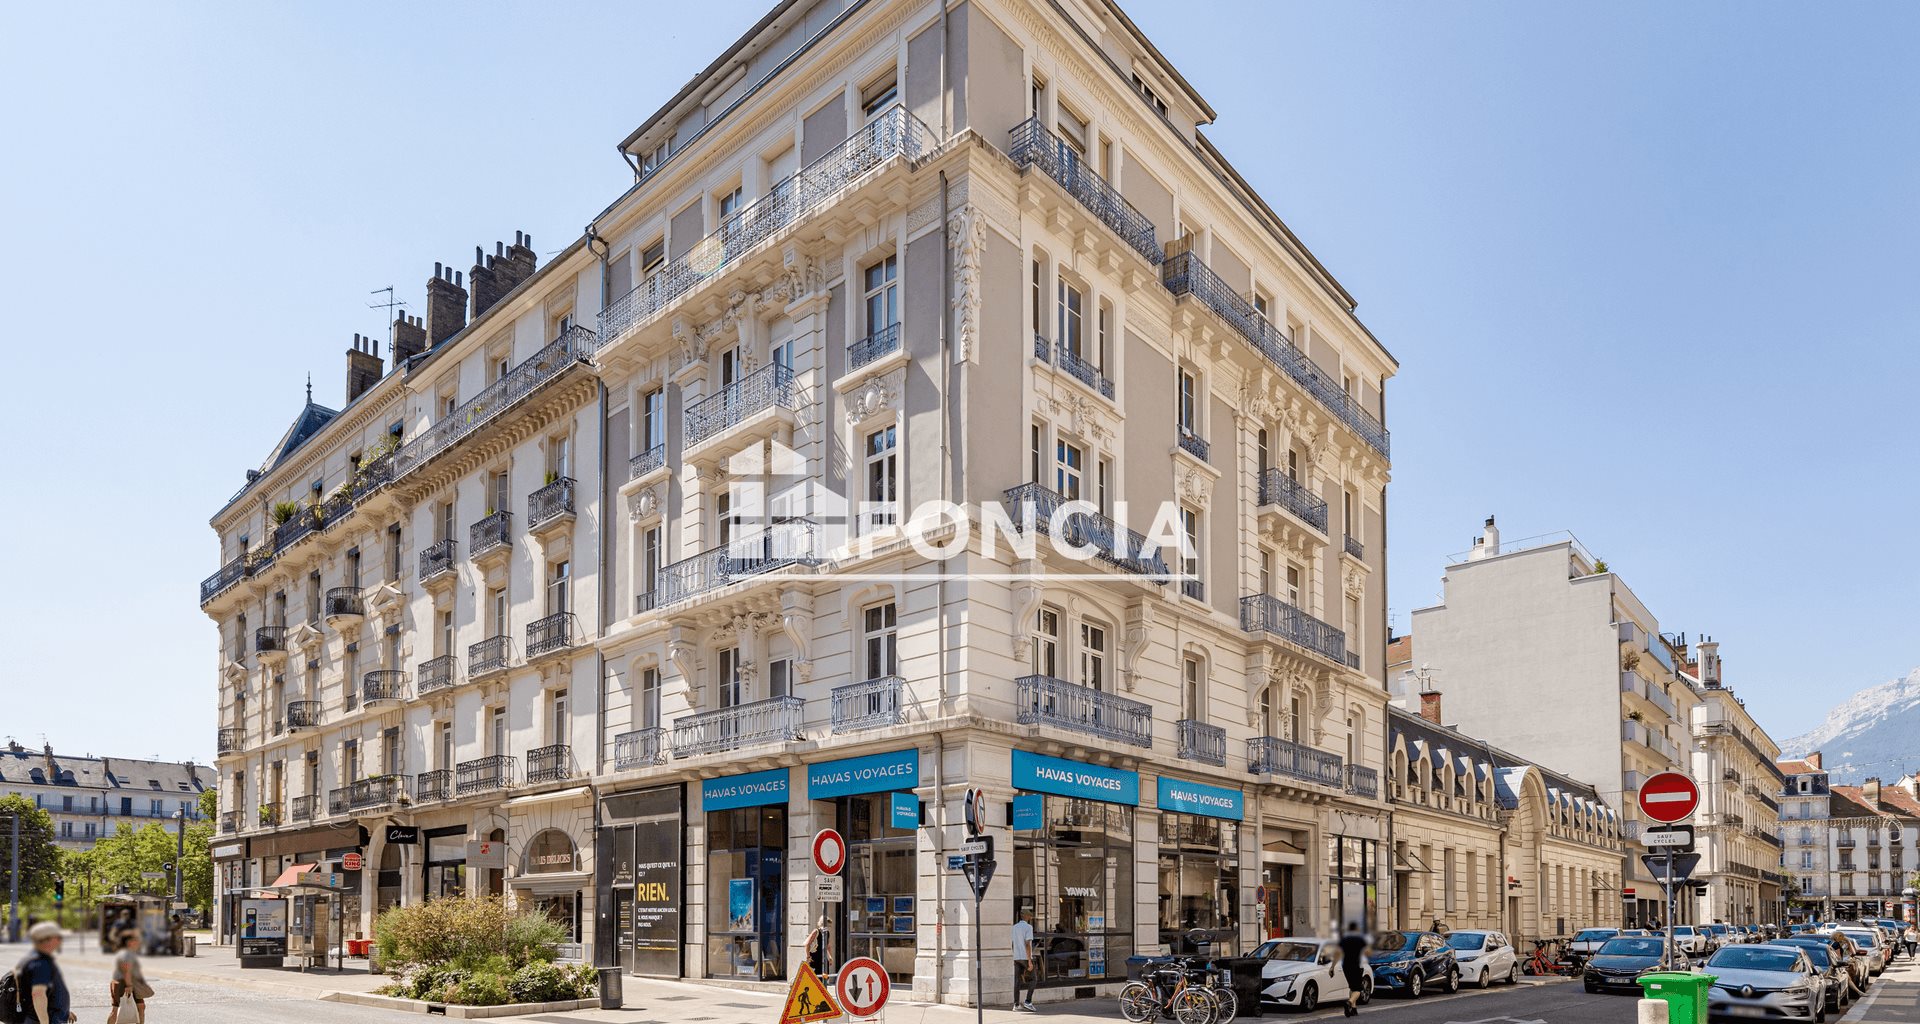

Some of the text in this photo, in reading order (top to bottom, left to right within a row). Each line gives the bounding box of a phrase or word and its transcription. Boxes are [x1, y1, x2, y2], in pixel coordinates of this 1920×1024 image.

[811, 762, 913, 786] HAVAS VOYAGES
[1036, 766, 1121, 790] HAVAS VOYAGES
[704, 779, 786, 799] HAVAS VOYAGES
[1170, 789, 1233, 808] HAVAS VOYAGES
[637, 882, 670, 902] RIEN.
